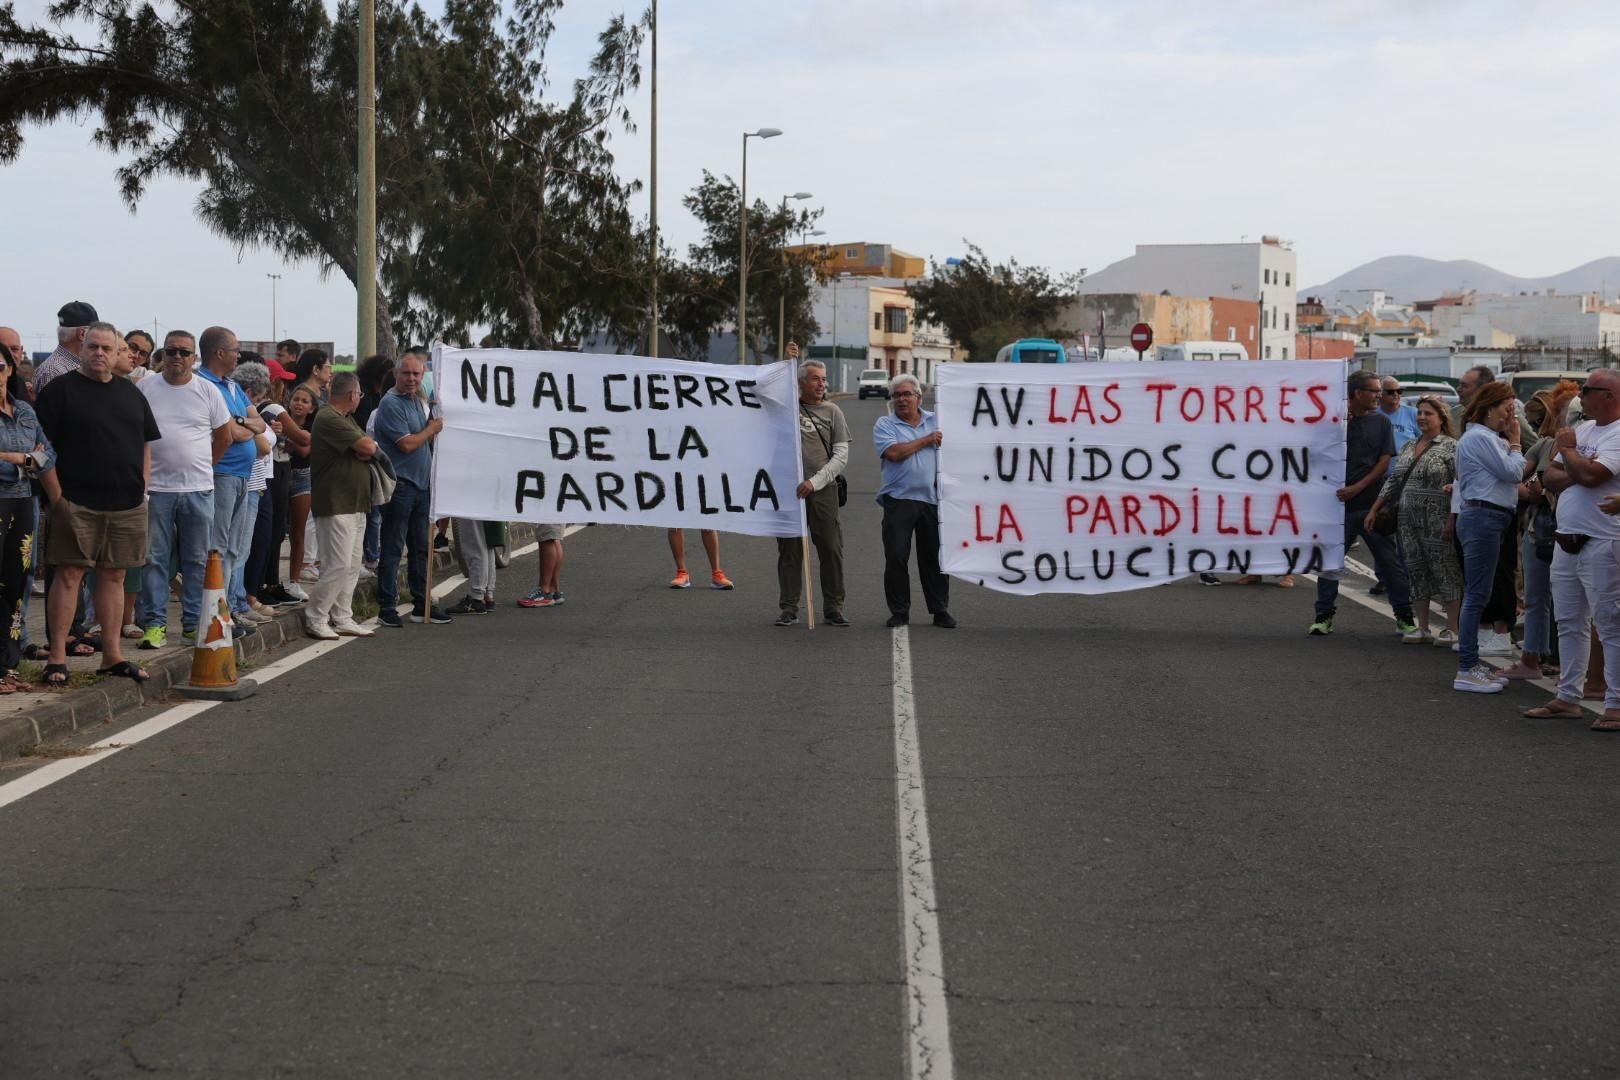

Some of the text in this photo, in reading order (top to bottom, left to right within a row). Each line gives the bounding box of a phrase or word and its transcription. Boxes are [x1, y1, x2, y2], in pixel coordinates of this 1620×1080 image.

[460, 358, 762, 412] NO AL CIERRE
[971, 385, 1033, 427] AV.
[1047, 383, 1122, 425] LAS
[548, 425, 709, 461] DE LA
[515, 468, 780, 514] PARDILLA
[1283, 545, 1323, 575] YA
